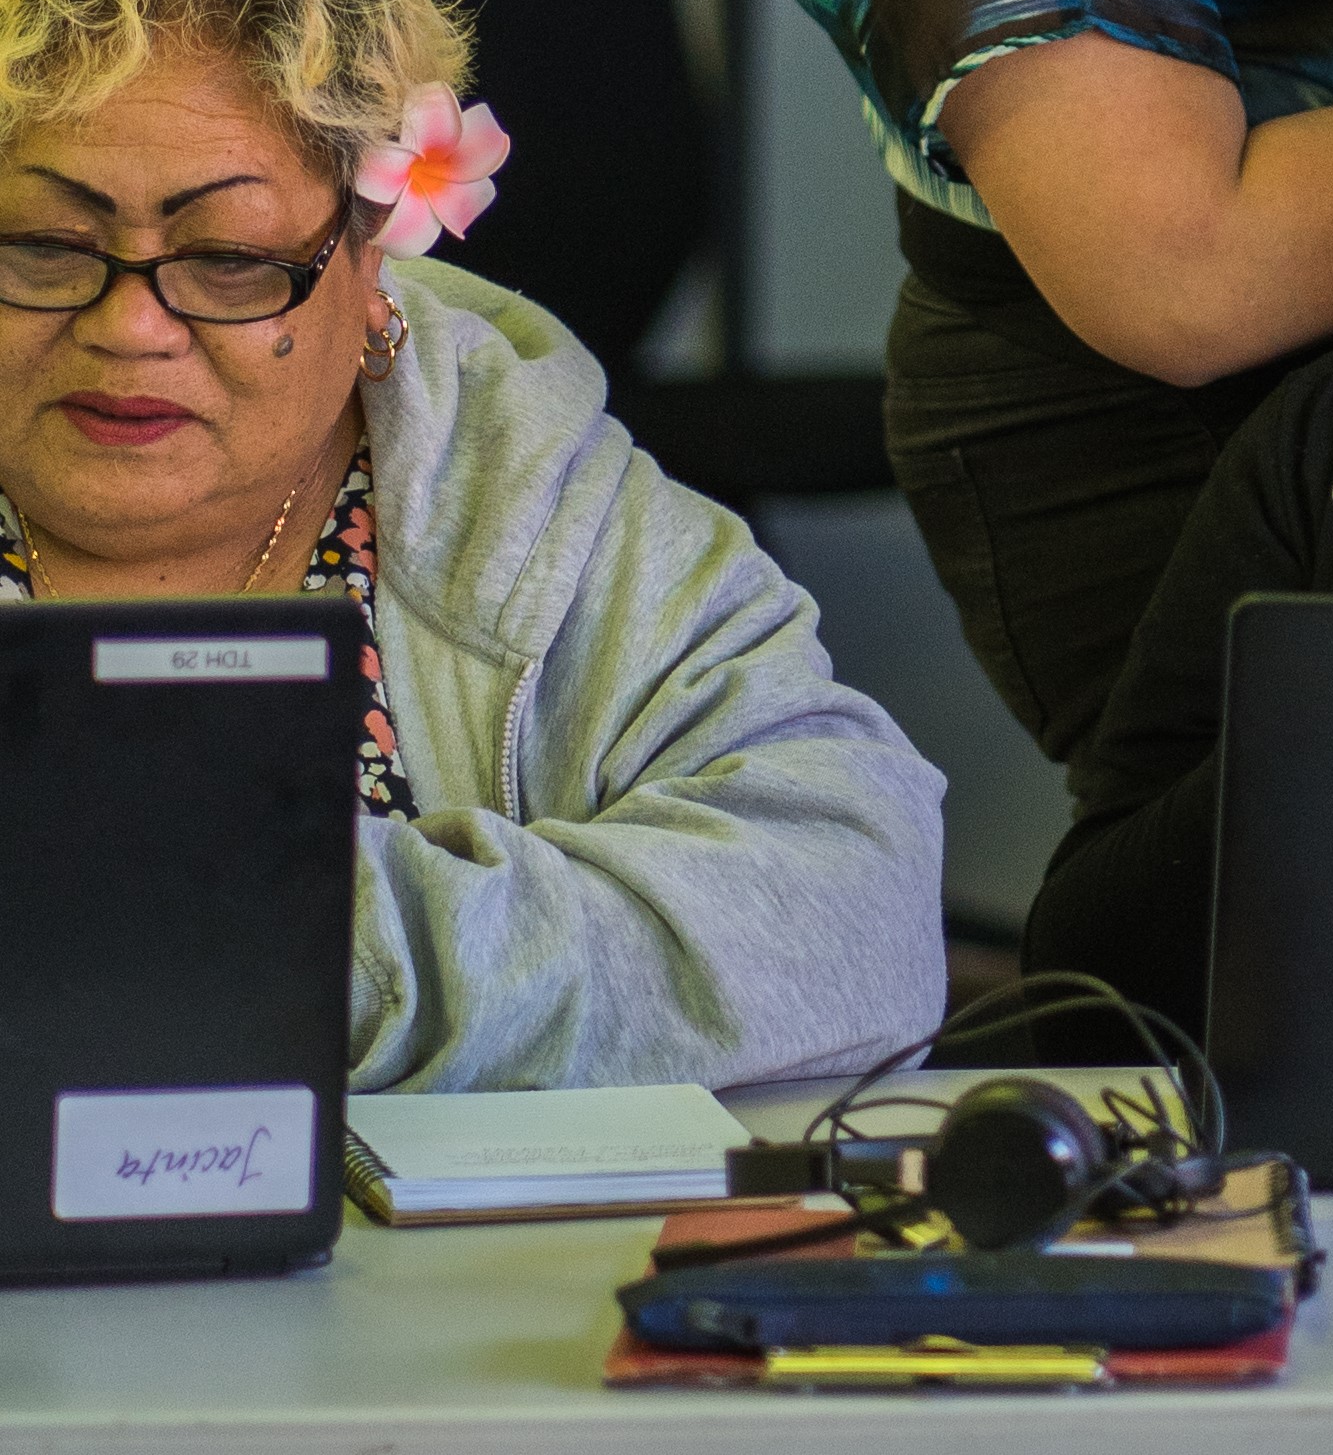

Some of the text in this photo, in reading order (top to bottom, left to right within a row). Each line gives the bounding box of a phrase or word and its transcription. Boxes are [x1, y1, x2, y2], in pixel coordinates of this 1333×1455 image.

[170, 650, 252, 670] TDH 29
[115, 1126, 272, 1188] Jacinta
